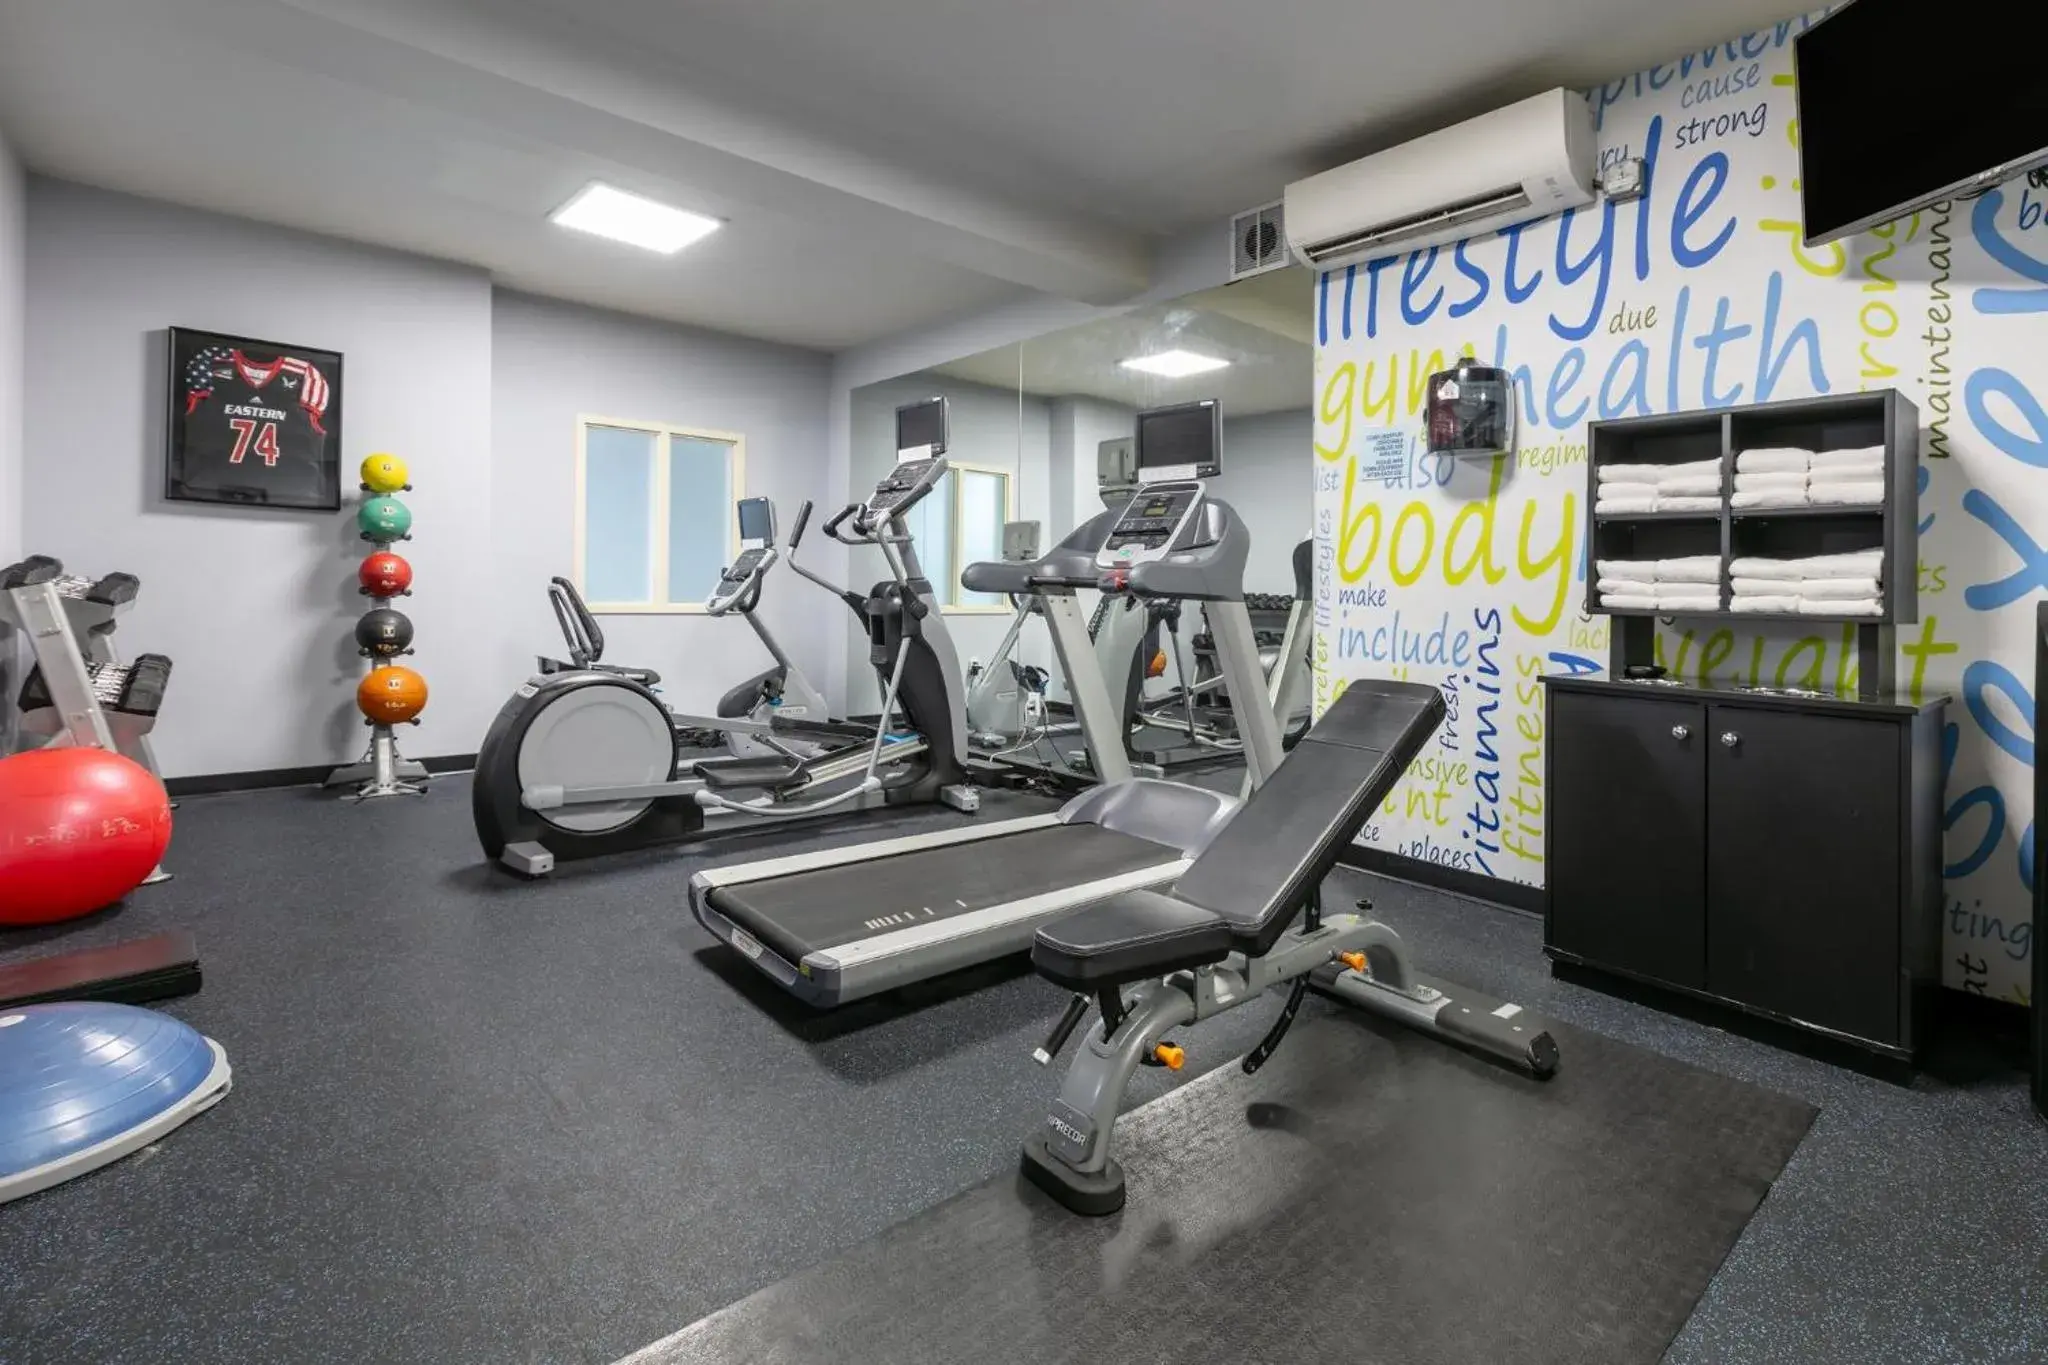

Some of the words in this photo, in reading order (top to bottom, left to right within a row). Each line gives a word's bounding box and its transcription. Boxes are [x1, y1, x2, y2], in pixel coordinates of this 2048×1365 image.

[1680, 63, 1761, 109] cause
[1675, 103, 1767, 149] strong
[1609, 301, 1658, 334] due
[1494, 270, 1831, 429] health
[224, 404, 287, 421] EASTERN
[229, 418, 280, 467] 74
[1518, 435, 1590, 477] regim
[1314, 466, 1339, 493] list
[1315, 508, 1336, 628] lifestyles
[1338, 454, 1576, 636] body
[1339, 581, 1387, 607] make
[1338, 610, 1471, 667] include
[1439, 673, 1460, 750] fresh
[1409, 751, 1469, 786] nsive
[1502, 654, 1544, 863] fitness
